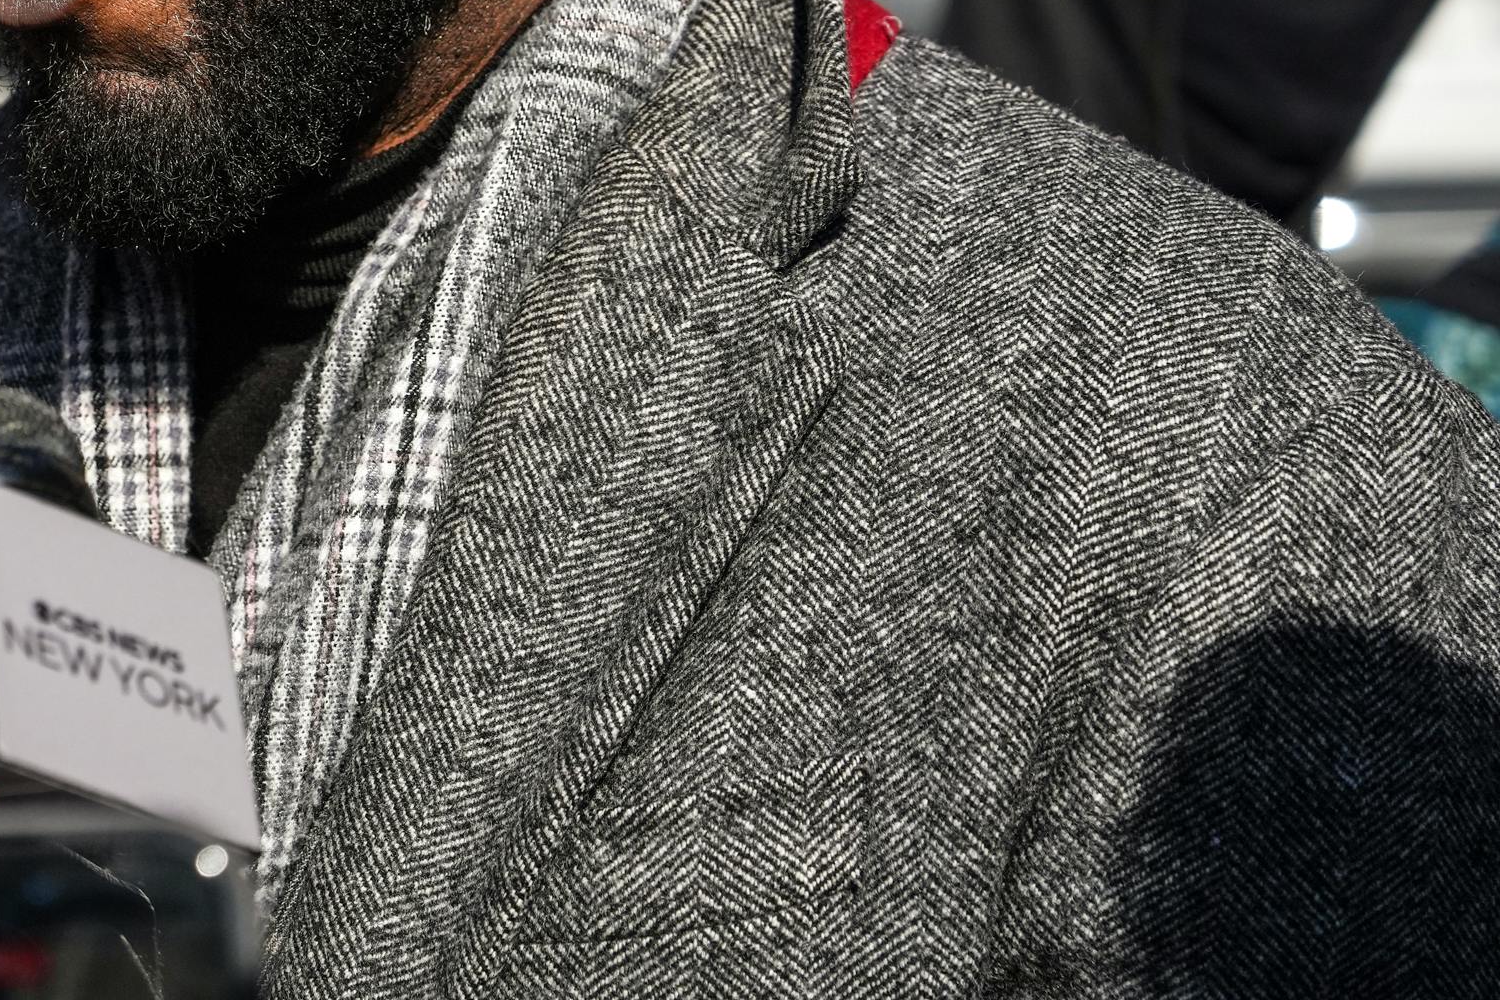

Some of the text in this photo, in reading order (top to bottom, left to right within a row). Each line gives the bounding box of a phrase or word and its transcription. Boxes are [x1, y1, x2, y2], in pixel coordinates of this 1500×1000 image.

[2, 618, 226, 732] NEW YORK
[107, 629, 185, 674] NEWS
